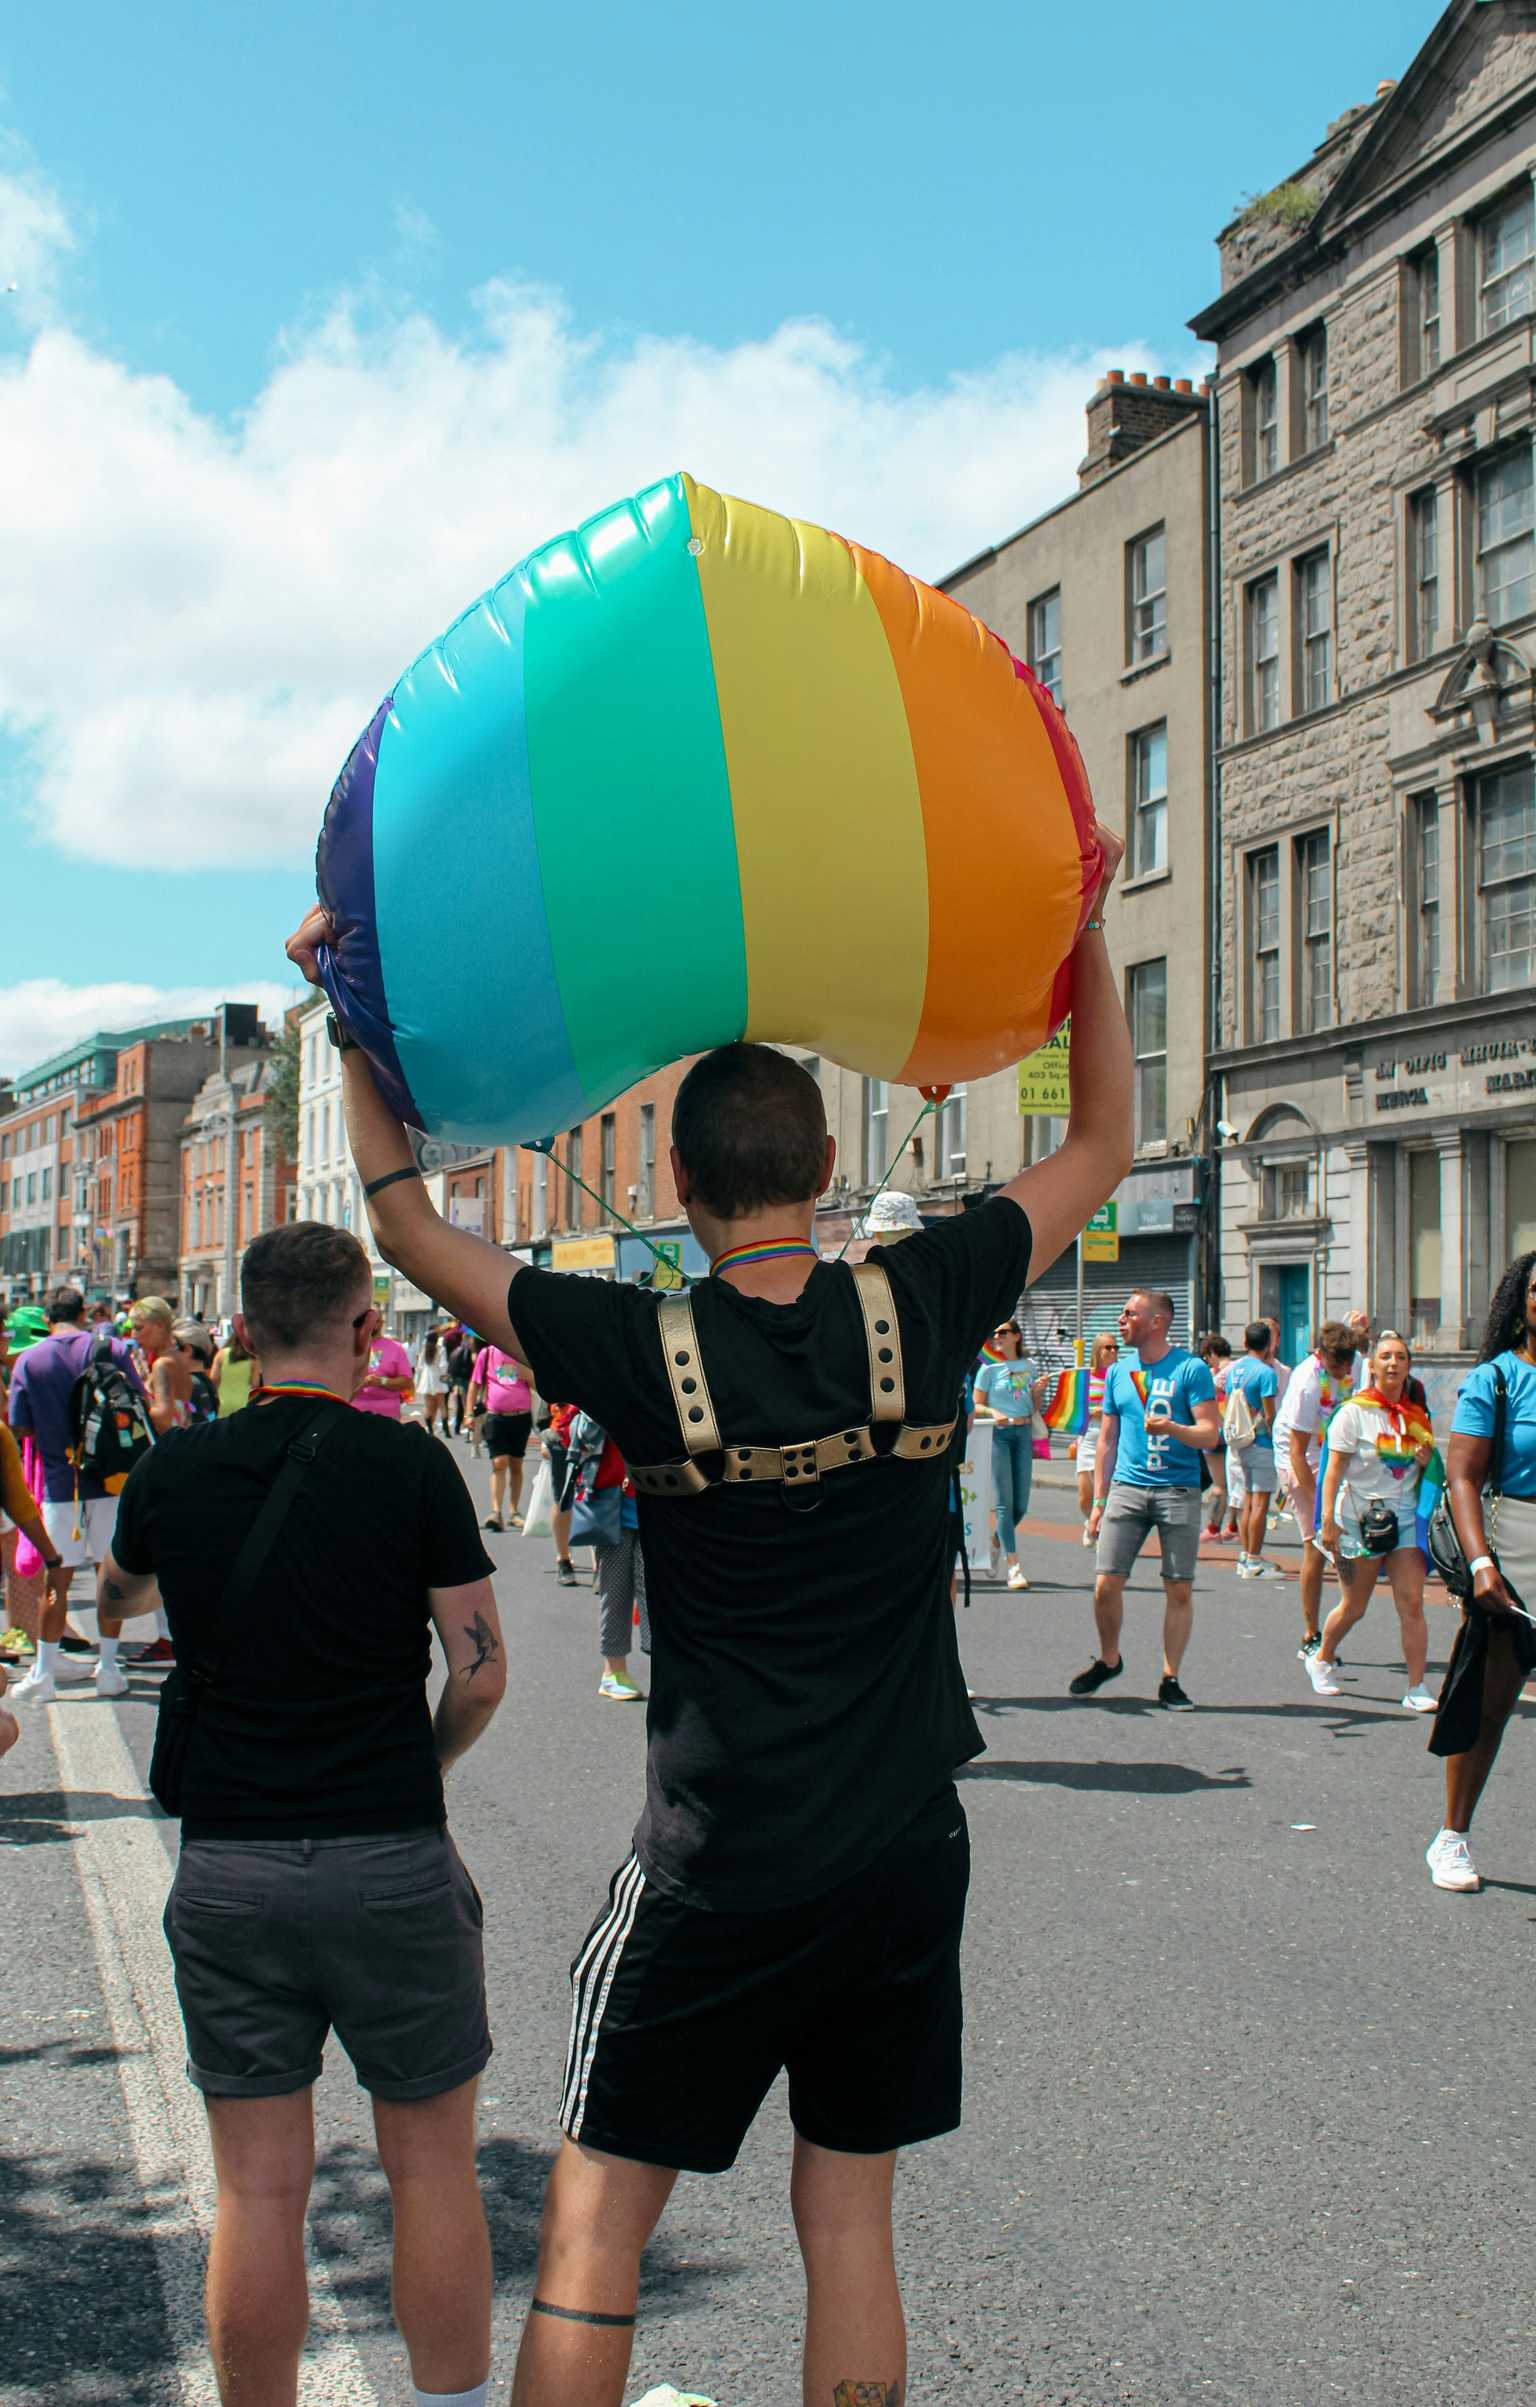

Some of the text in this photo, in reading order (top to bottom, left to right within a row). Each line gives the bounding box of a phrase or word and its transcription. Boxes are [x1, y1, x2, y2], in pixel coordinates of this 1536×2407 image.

[1041, 1035, 1069, 1049] AL
[1020, 1087, 1035, 1100] 01
[1146, 1378, 1176, 1471] PRDE
